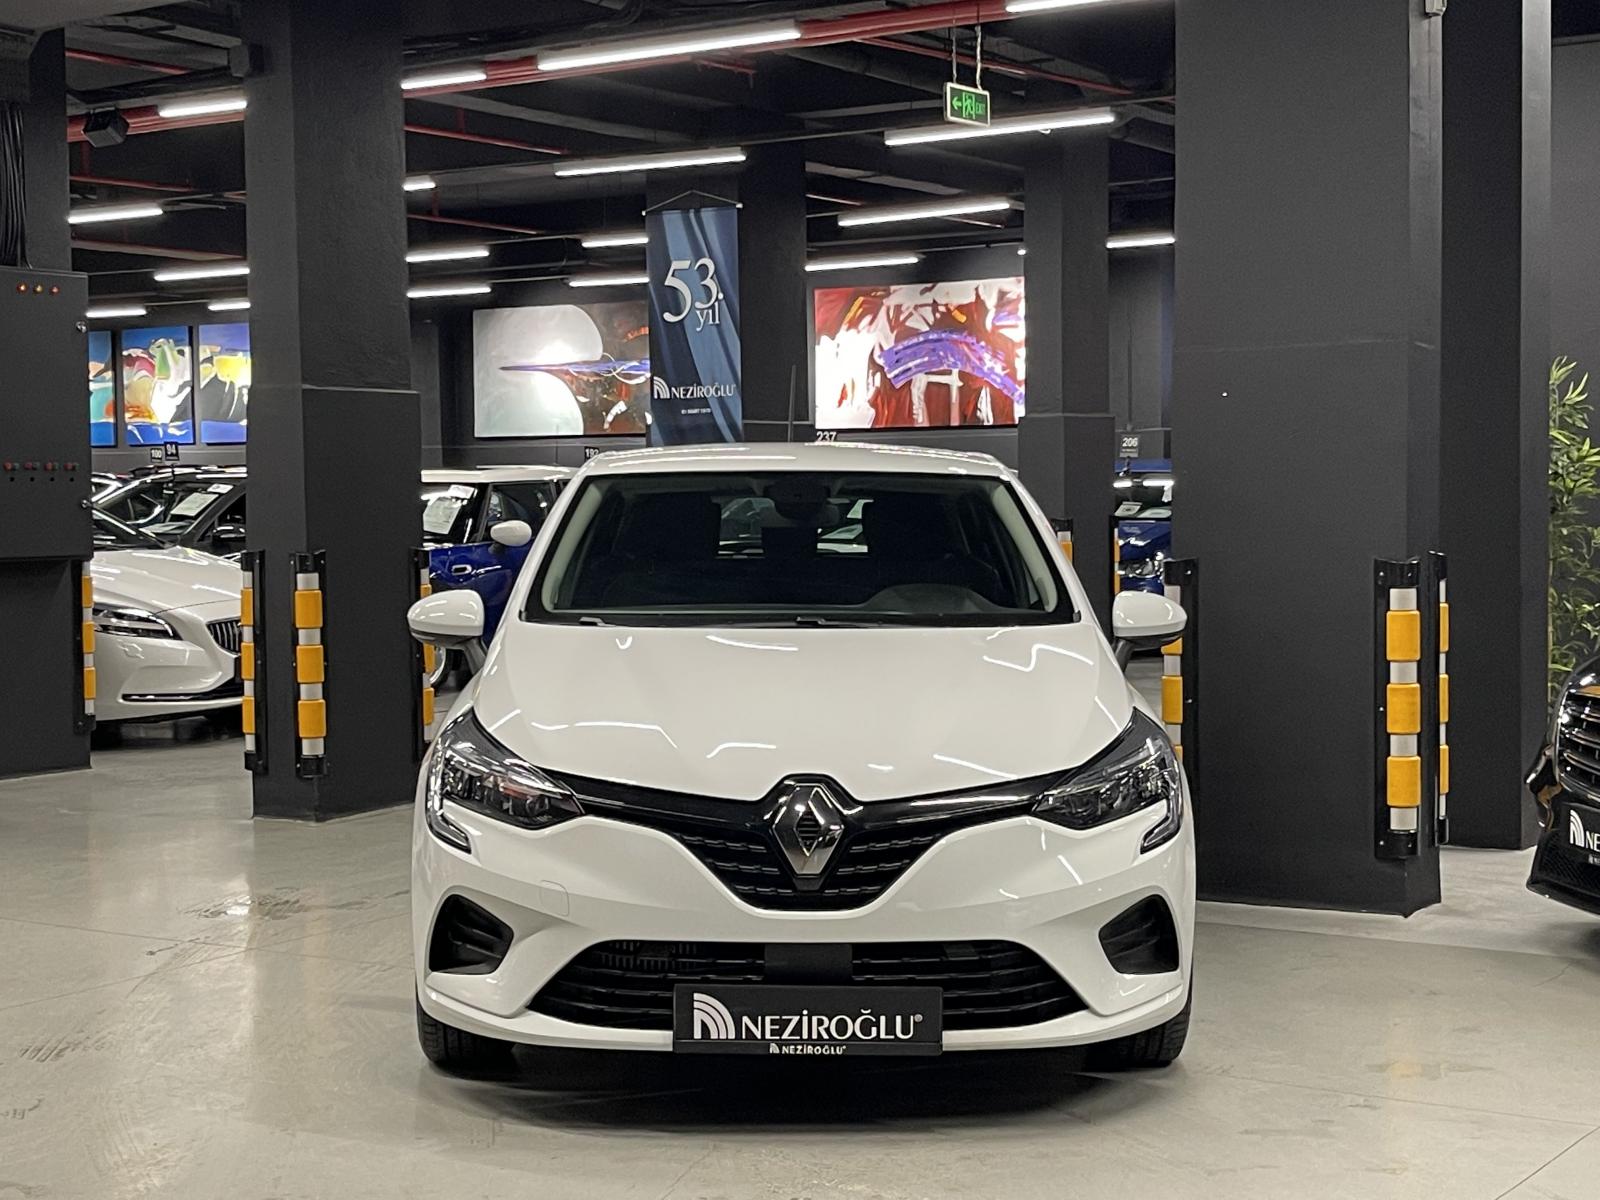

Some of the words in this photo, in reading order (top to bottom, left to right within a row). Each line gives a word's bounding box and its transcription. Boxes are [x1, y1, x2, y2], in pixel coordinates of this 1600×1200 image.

[696, 301, 720, 332] yıl
[671, 382, 734, 400] NEZİROĞLU
[816, 431, 837, 442] 237
[166, 444, 177, 455] 94
[741, 1008, 915, 1040] NEZİROĞLU
